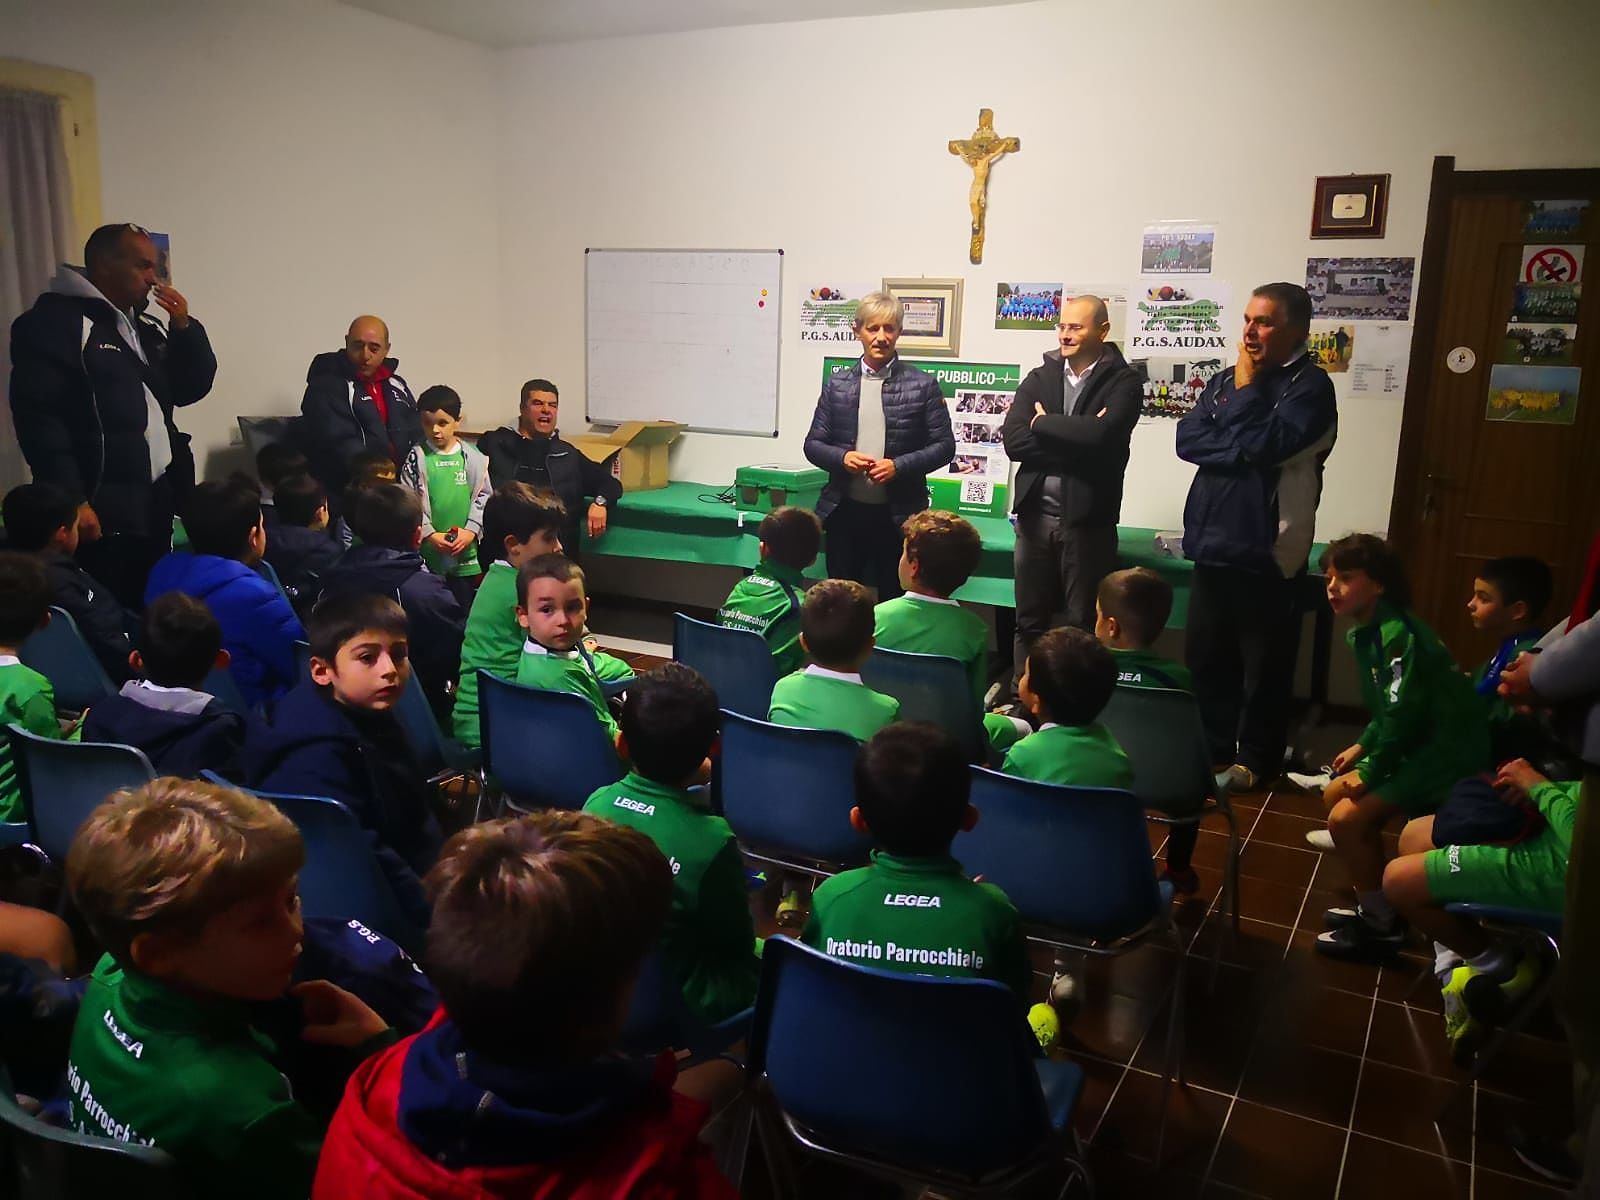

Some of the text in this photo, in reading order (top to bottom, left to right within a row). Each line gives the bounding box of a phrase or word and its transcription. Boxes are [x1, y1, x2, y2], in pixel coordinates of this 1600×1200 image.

[801, 331, 857, 341] P.G.S.AUD
[1132, 336, 1226, 348] P.G.S.AUDAX
[937, 369, 996, 386] PUBBLICO
[1190, 368, 1217, 378] ADA
[613, 796, 656, 816] LEGEA
[884, 893, 942, 908] LEGEA
[826, 936, 985, 970] Oratorio Parrocchiale
[80, 1080, 156, 1148] Parrocch
